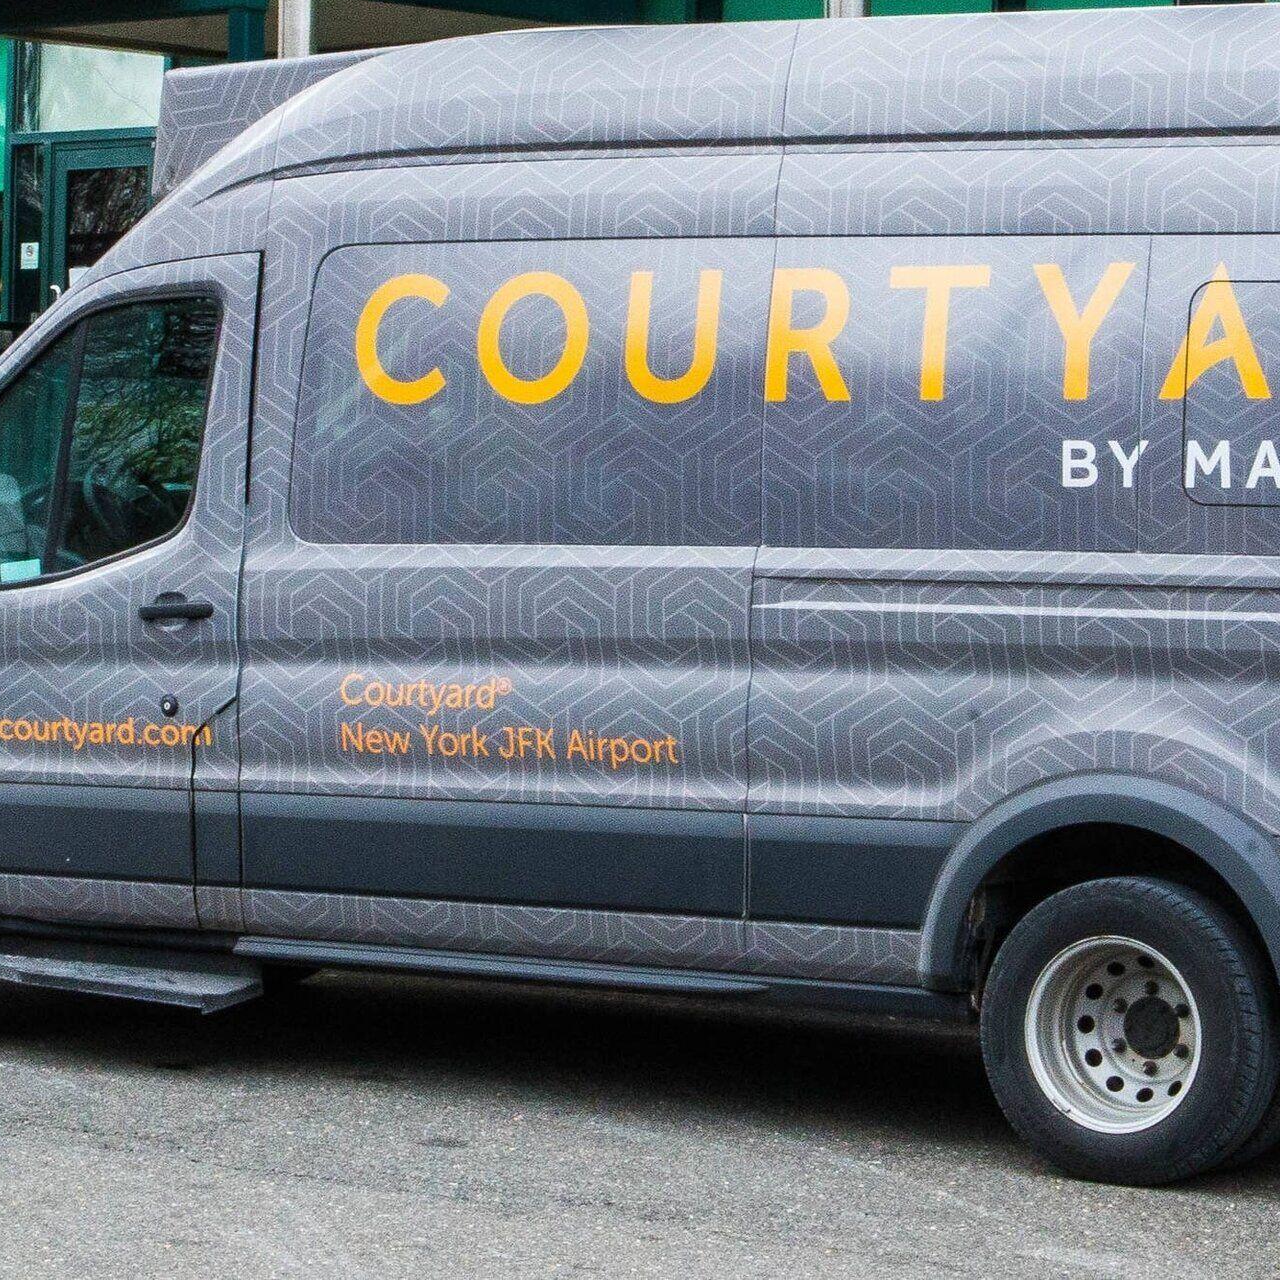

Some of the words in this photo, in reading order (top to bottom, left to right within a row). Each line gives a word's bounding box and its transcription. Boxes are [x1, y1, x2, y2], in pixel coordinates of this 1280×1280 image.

[1061, 437, 1151, 488] BY
[339, 722, 411, 756] New
[420, 724, 491, 758] York
[498, 726, 558, 760] JFK
[566, 728, 679, 771] Airport
